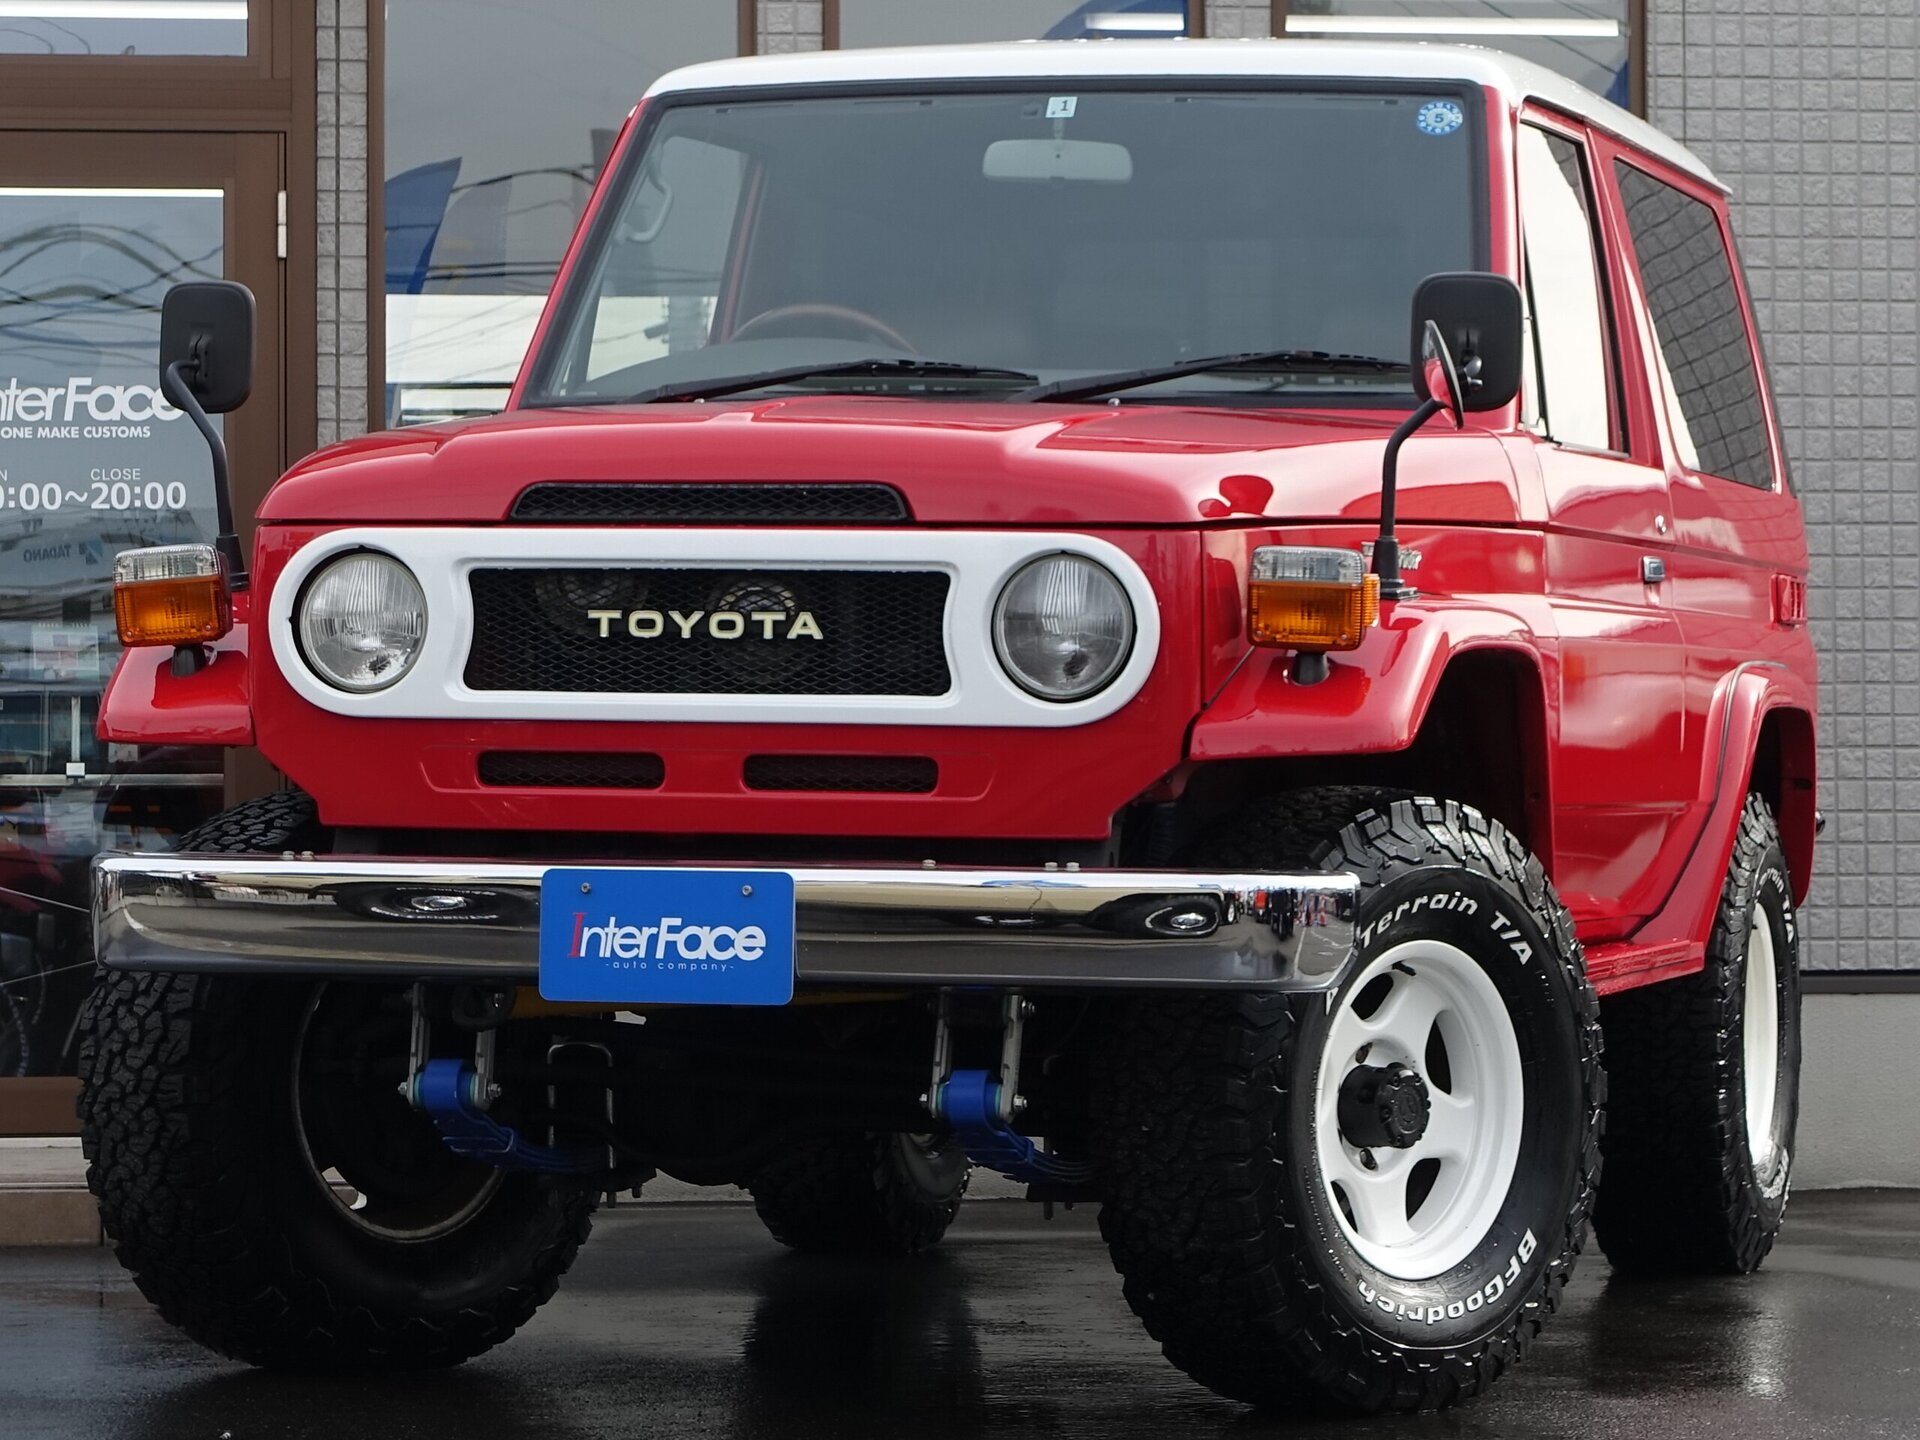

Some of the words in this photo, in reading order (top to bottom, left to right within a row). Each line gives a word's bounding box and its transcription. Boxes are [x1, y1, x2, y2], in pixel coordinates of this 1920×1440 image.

[1060, 99, 1069, 112] 1
[1434, 113, 1445, 124] 5
[0, 426, 33, 439] ONE
[37, 426, 80, 439] MAKE
[83, 425, 151, 440] CUSTOMS
[90, 468, 142, 482] CLOSE
[587, 609, 824, 640] TOYOTA
[567, 912, 767, 962] InterFace
[1360, 891, 1479, 949] Terrain
[1490, 910, 1534, 966] T/A
[1356, 1227, 1538, 1325] BFGoodrich
